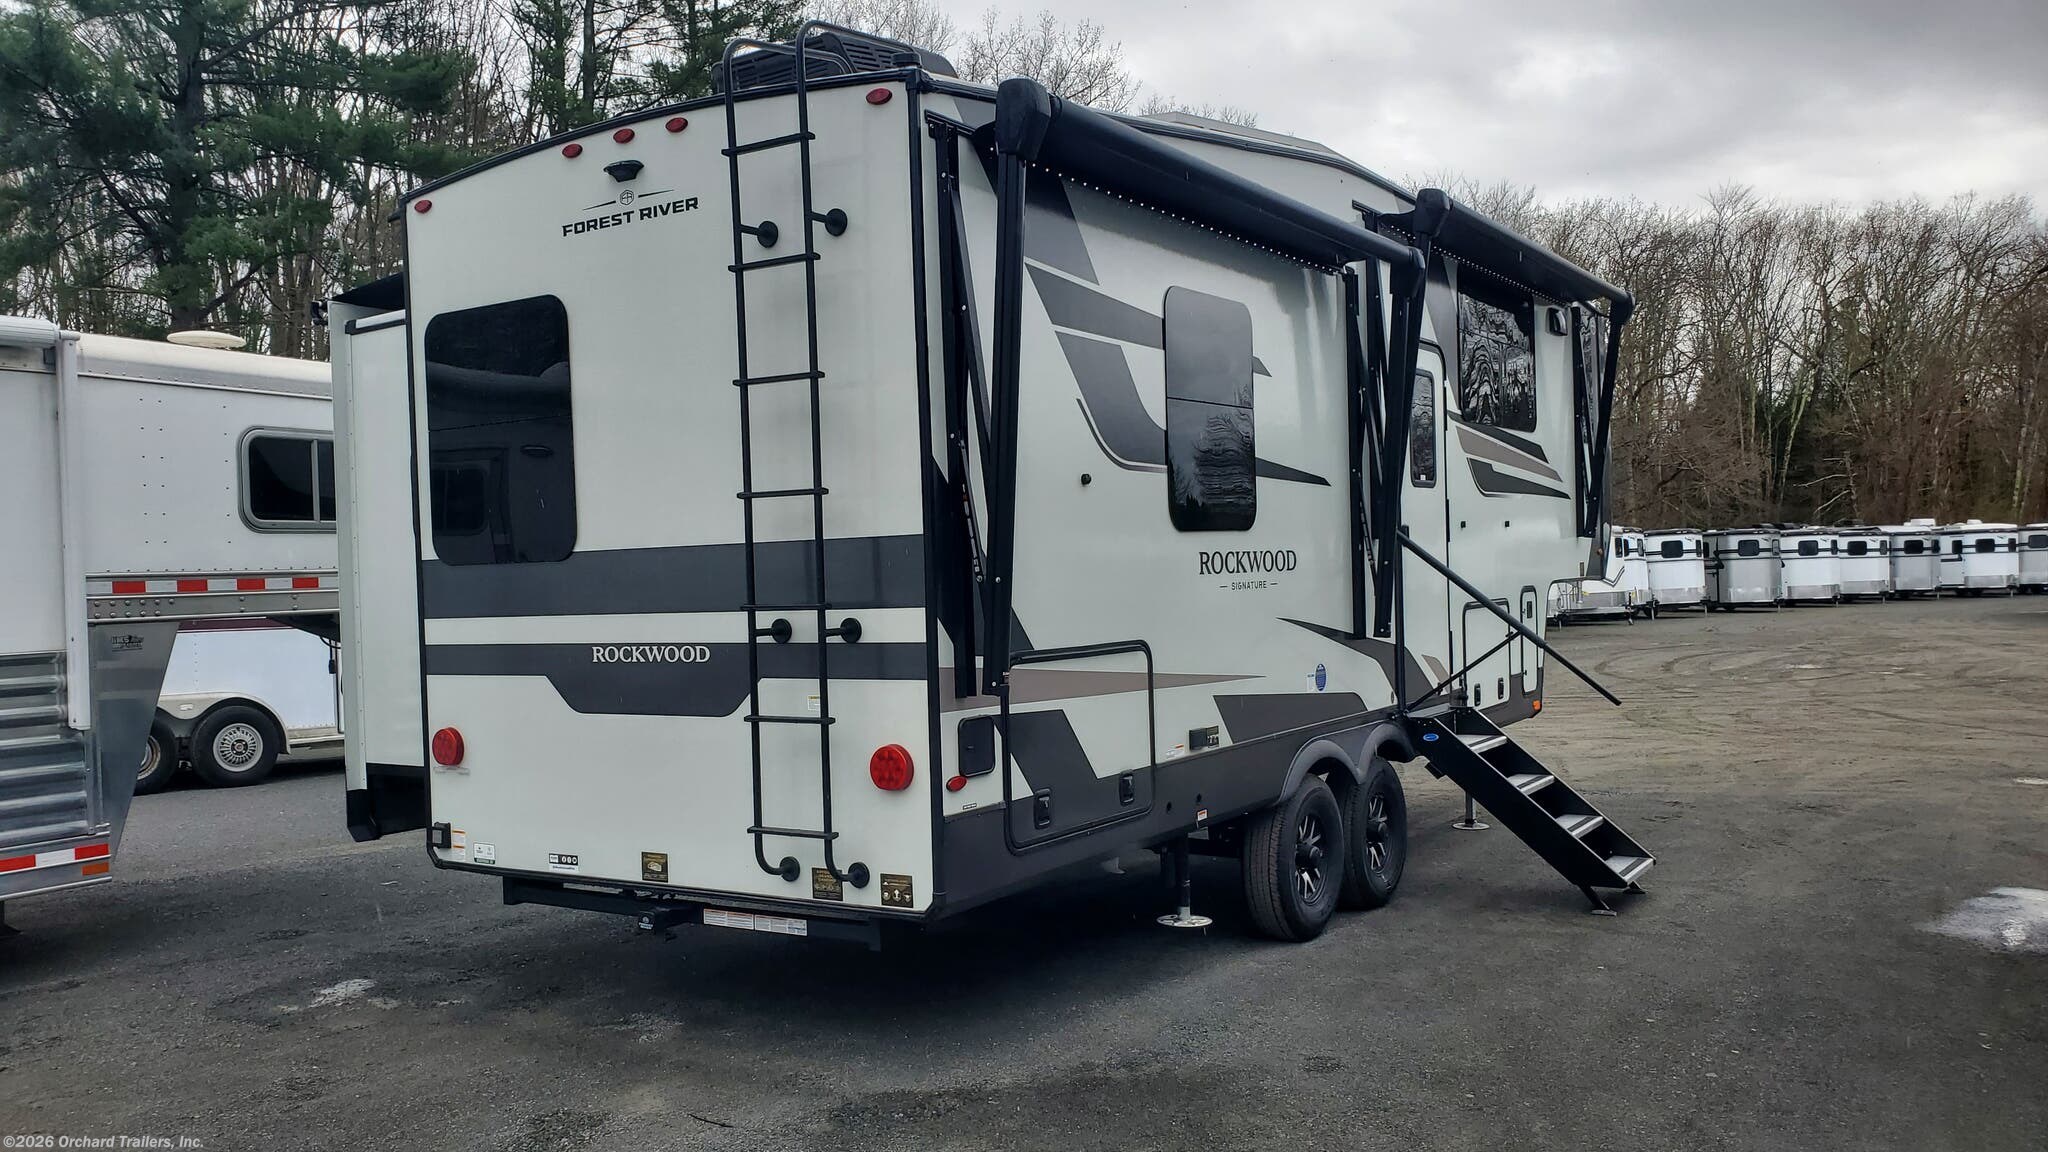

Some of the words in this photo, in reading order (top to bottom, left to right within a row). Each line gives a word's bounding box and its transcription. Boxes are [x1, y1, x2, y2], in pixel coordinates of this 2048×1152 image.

[561, 210, 634, 237] FOREST
[639, 197, 699, 220] RIVER
[1198, 550, 1297, 575] ROCKWOOD
[1231, 580, 1268, 591] SIGNATURE
[591, 645, 711, 663] ROCKWOOD
